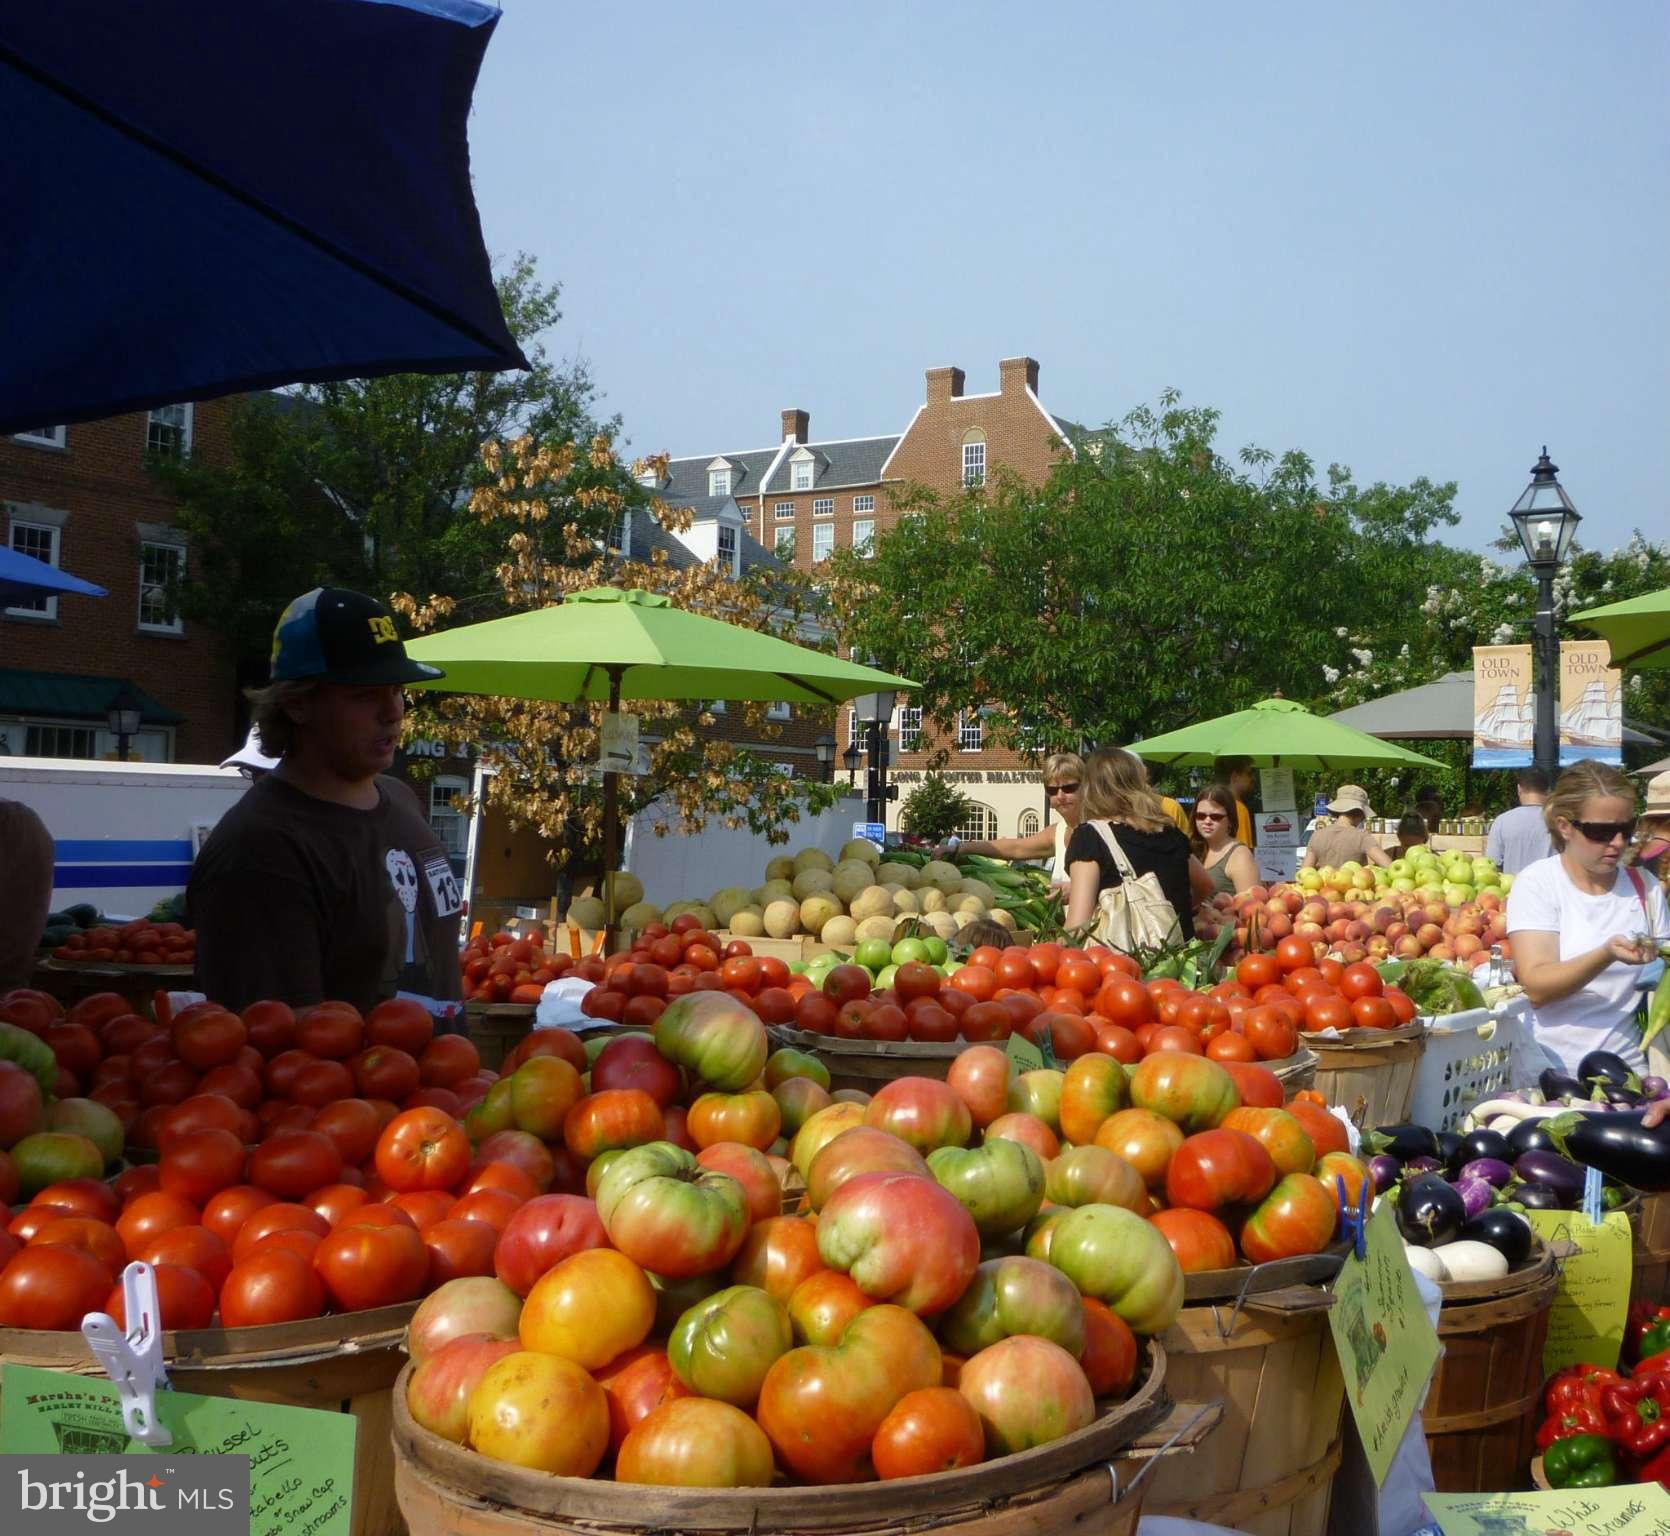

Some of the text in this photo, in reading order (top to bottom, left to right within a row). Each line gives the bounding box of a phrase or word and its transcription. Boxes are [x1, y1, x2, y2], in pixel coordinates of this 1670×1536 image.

[1482, 658, 1510, 669] OLD
[1569, 654, 1598, 665] OLD
[1480, 668, 1520, 679] TOWN
[1567, 665, 1609, 674] TOWN
[437, 876, 460, 911] 13
